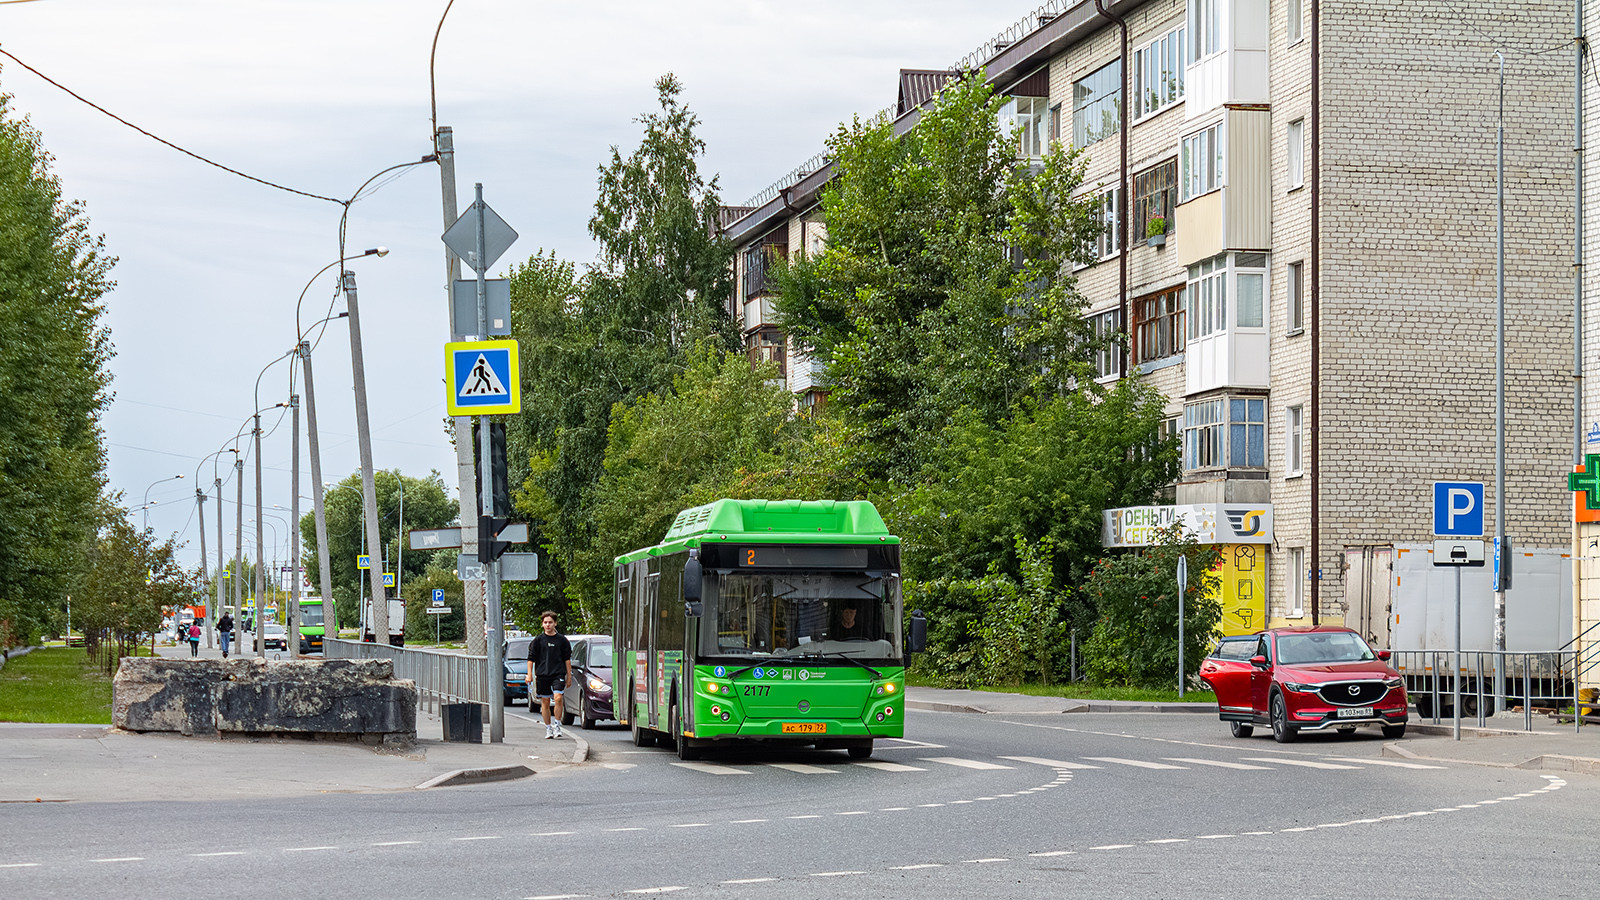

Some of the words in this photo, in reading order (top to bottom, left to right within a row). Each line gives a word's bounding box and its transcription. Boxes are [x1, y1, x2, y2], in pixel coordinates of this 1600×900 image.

[1447, 488, 1475, 530] P
[747, 549, 755, 565] 2
[435, 590, 443, 600] P
[743, 685, 771, 697] 2177
[799, 724, 813, 732] 179
